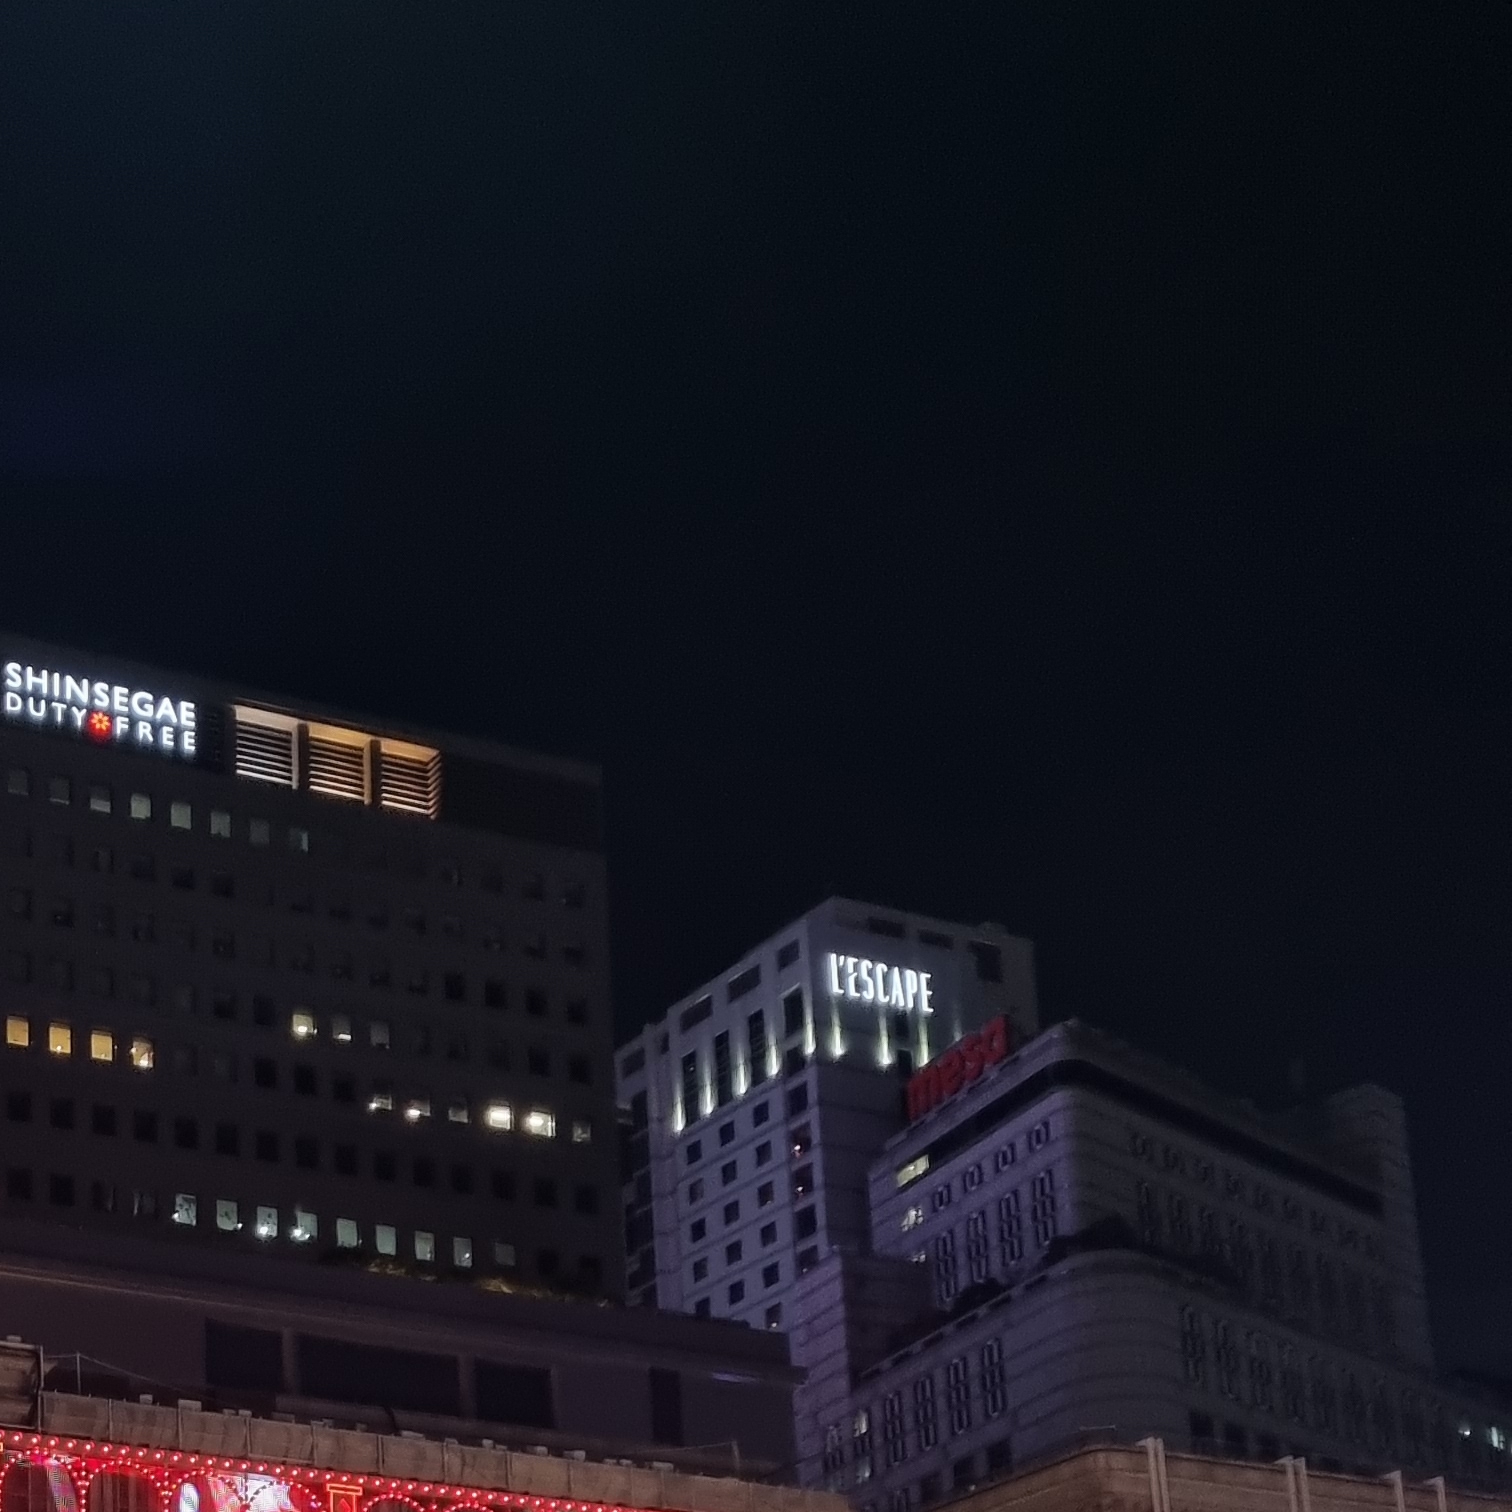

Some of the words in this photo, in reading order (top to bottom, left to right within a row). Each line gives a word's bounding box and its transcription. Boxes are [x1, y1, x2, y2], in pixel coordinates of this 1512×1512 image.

[4, 661, 196, 728] SHINSEGAE
[5, 691, 87, 727] DUTY
[115, 715, 196, 752] FREE
[827, 952, 934, 1012] L'ESCAPE
